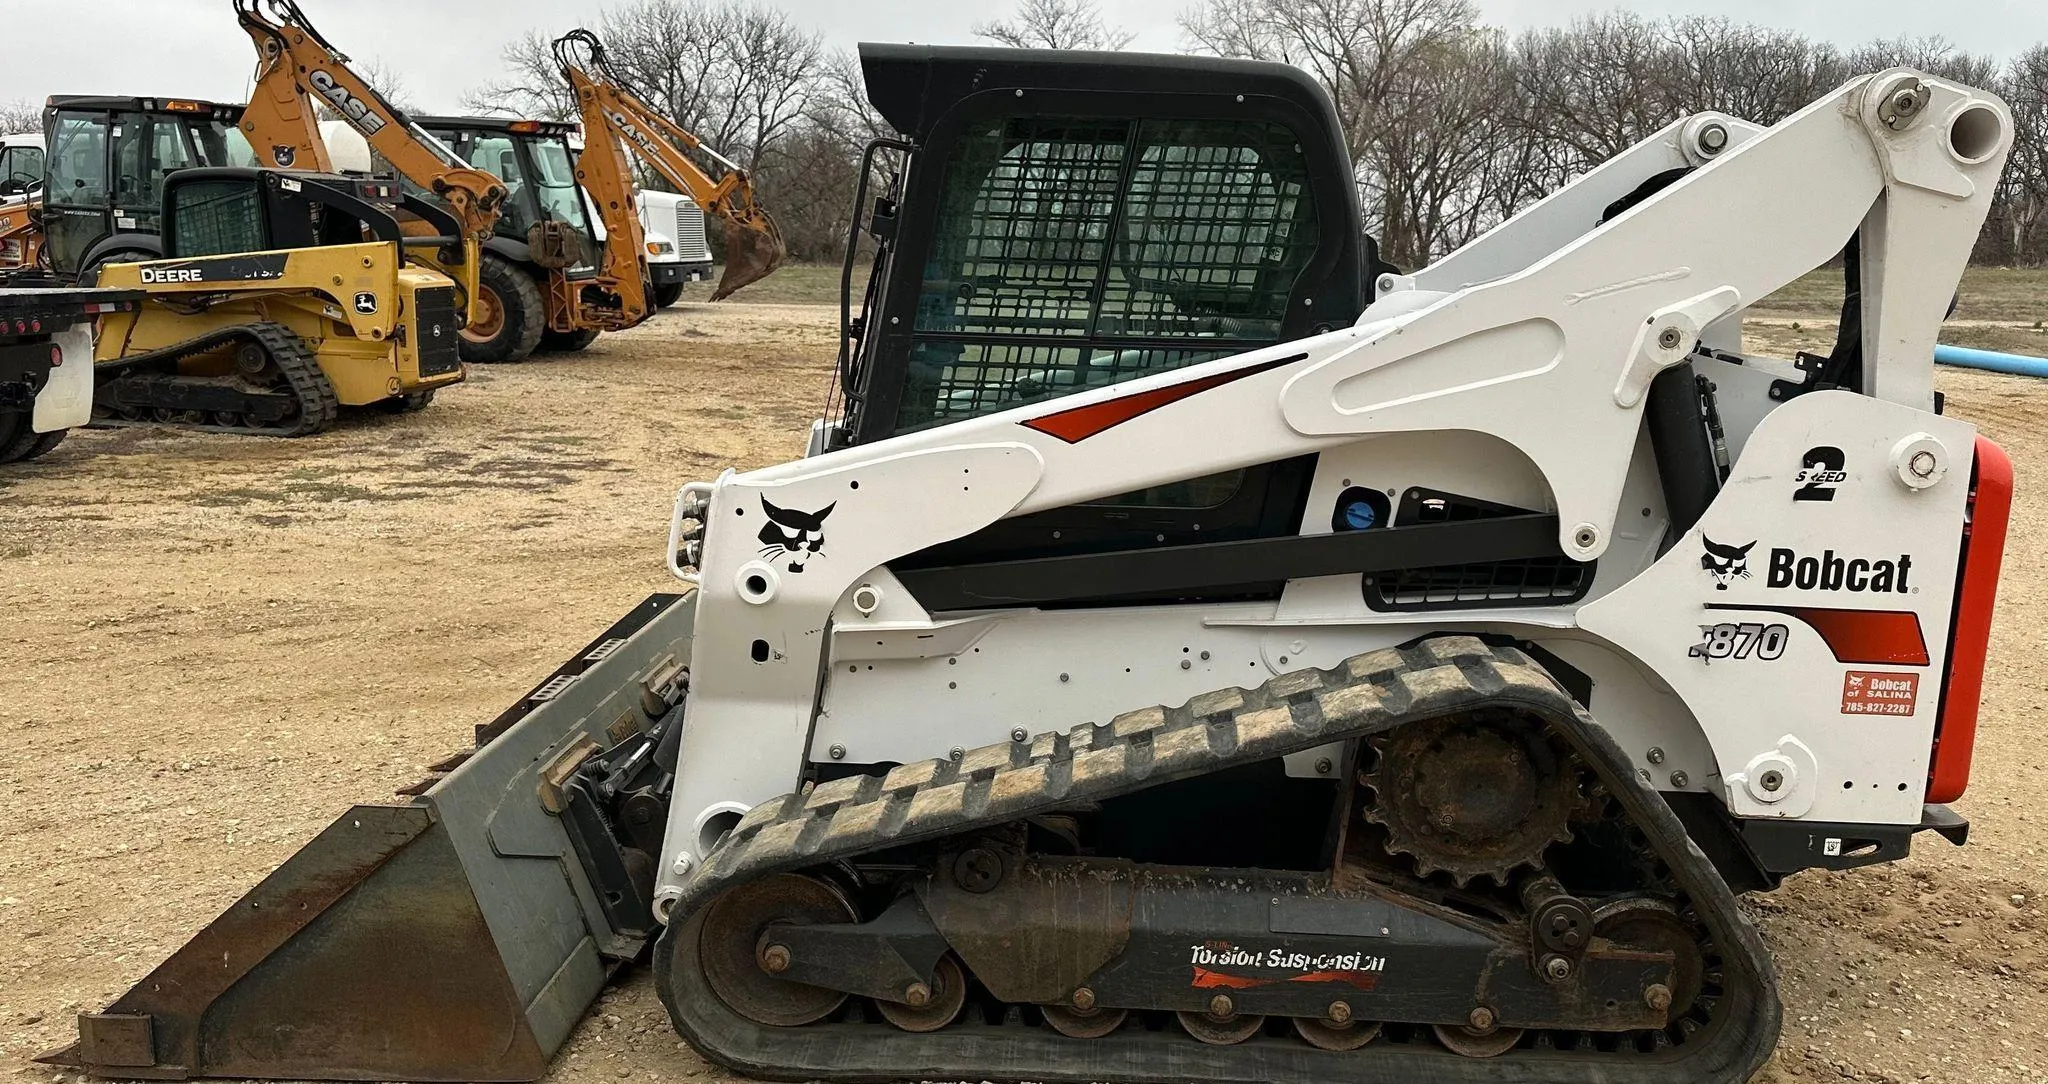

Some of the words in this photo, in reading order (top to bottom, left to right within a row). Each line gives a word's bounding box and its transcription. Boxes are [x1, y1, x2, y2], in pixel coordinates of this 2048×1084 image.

[310, 70, 386, 135] CASE
[611, 112, 659, 156] CASE
[140, 268, 203, 283] DEERE
[1793, 446, 1846, 501] 2
[1794, 470, 1848, 483] SEED
[1766, 547, 1912, 594] Bobcat
[1870, 678, 1912, 691] Bobcat
[1866, 691, 1912, 699] SALINA
[1845, 702, 1911, 714] 785-827-2287
